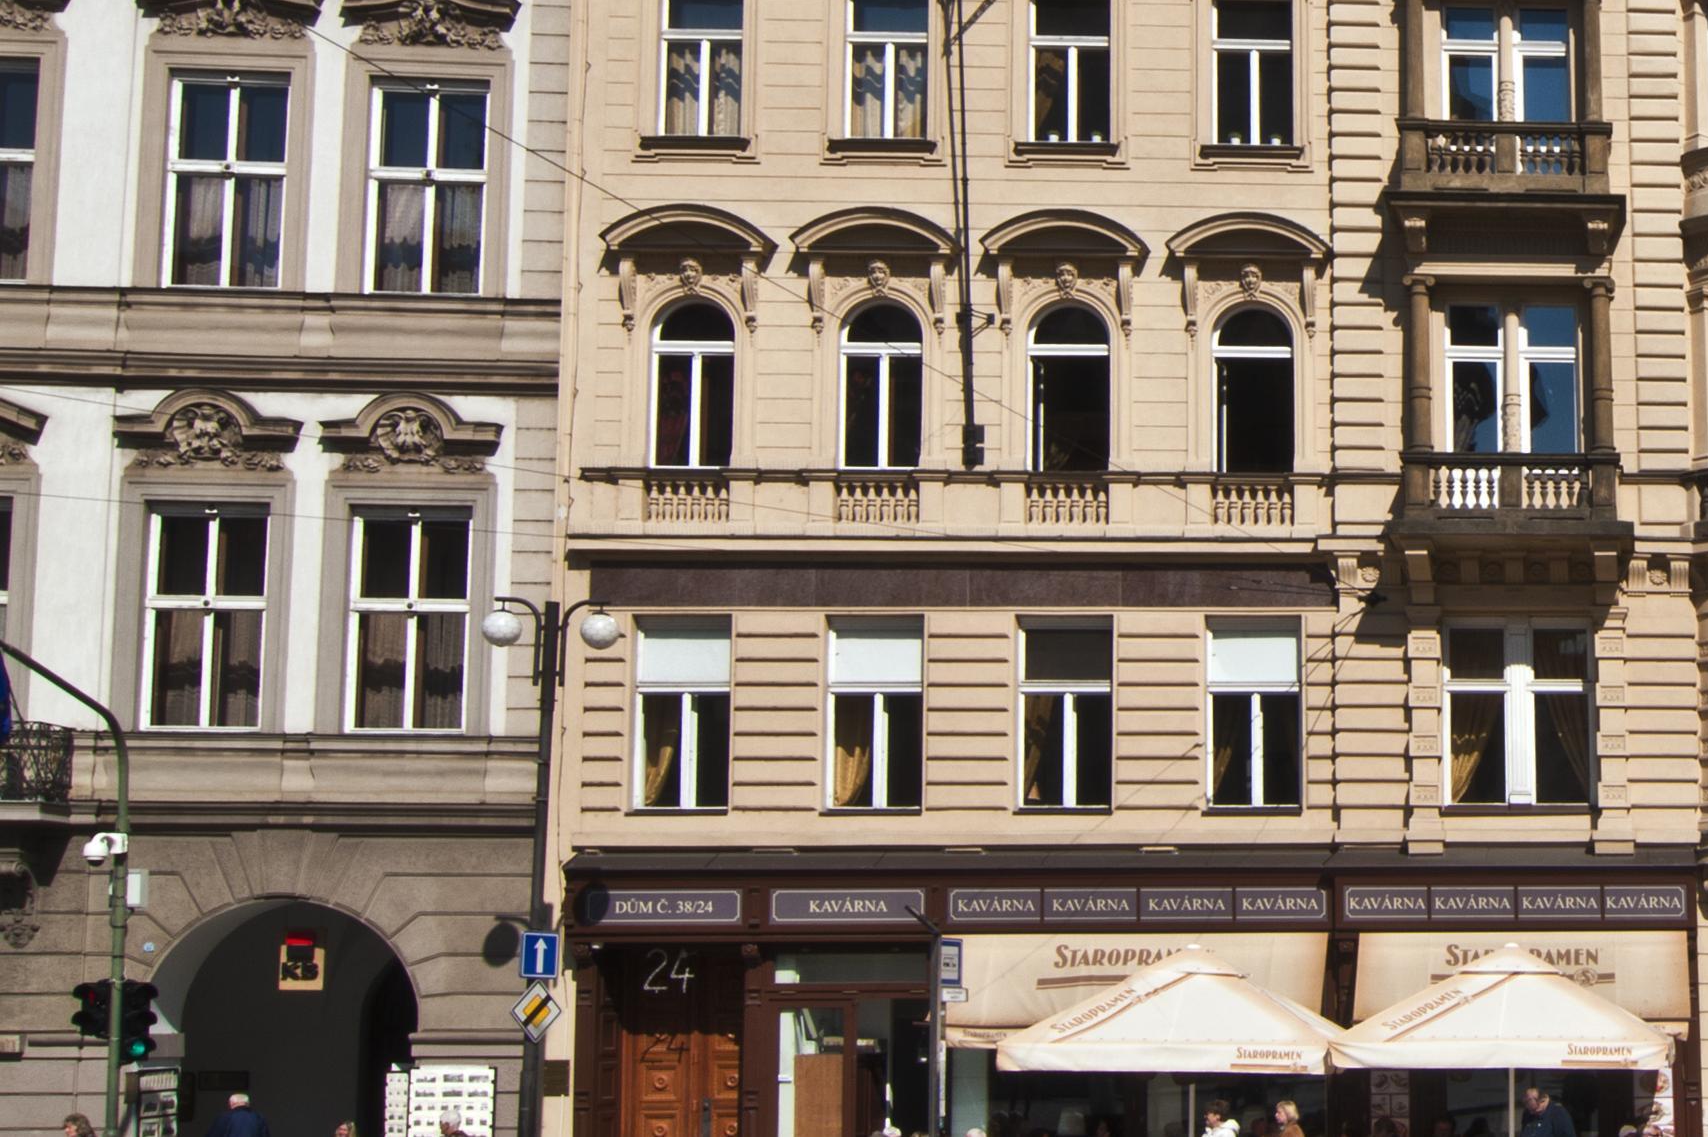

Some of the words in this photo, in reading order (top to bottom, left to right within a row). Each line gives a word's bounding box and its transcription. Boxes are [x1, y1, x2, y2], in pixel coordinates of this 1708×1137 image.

[615, 897, 653, 914] DŮM
[656, 897, 672, 914] Č.
[676, 899, 713, 914] 38/24
[809, 896, 887, 913] KAVÁRNA
[957, 895, 1035, 912] KAVÁRNA
[1052, 895, 1130, 912] KAVÁRNA
[1148, 895, 1226, 911] KAVÁRNA
[1242, 894, 1319, 911] KAVÁRNA
[1349, 893, 1426, 910] KAVÁRNA
[1435, 893, 1511, 910] KAVÁRNA
[1522, 893, 1598, 909] KAVÁRNA
[1606, 892, 1681, 909] KAVÁRNA
[281, 962, 319, 981] KB
[643, 949, 695, 993] 24
[1050, 987, 1137, 1034] STAROPRAMEN
[1381, 989, 1463, 1031] STAROPRAMEN
[1237, 1047, 1302, 1060] STAROPRAMEN
[1567, 1043, 1632, 1056] STAROPRAMEN
